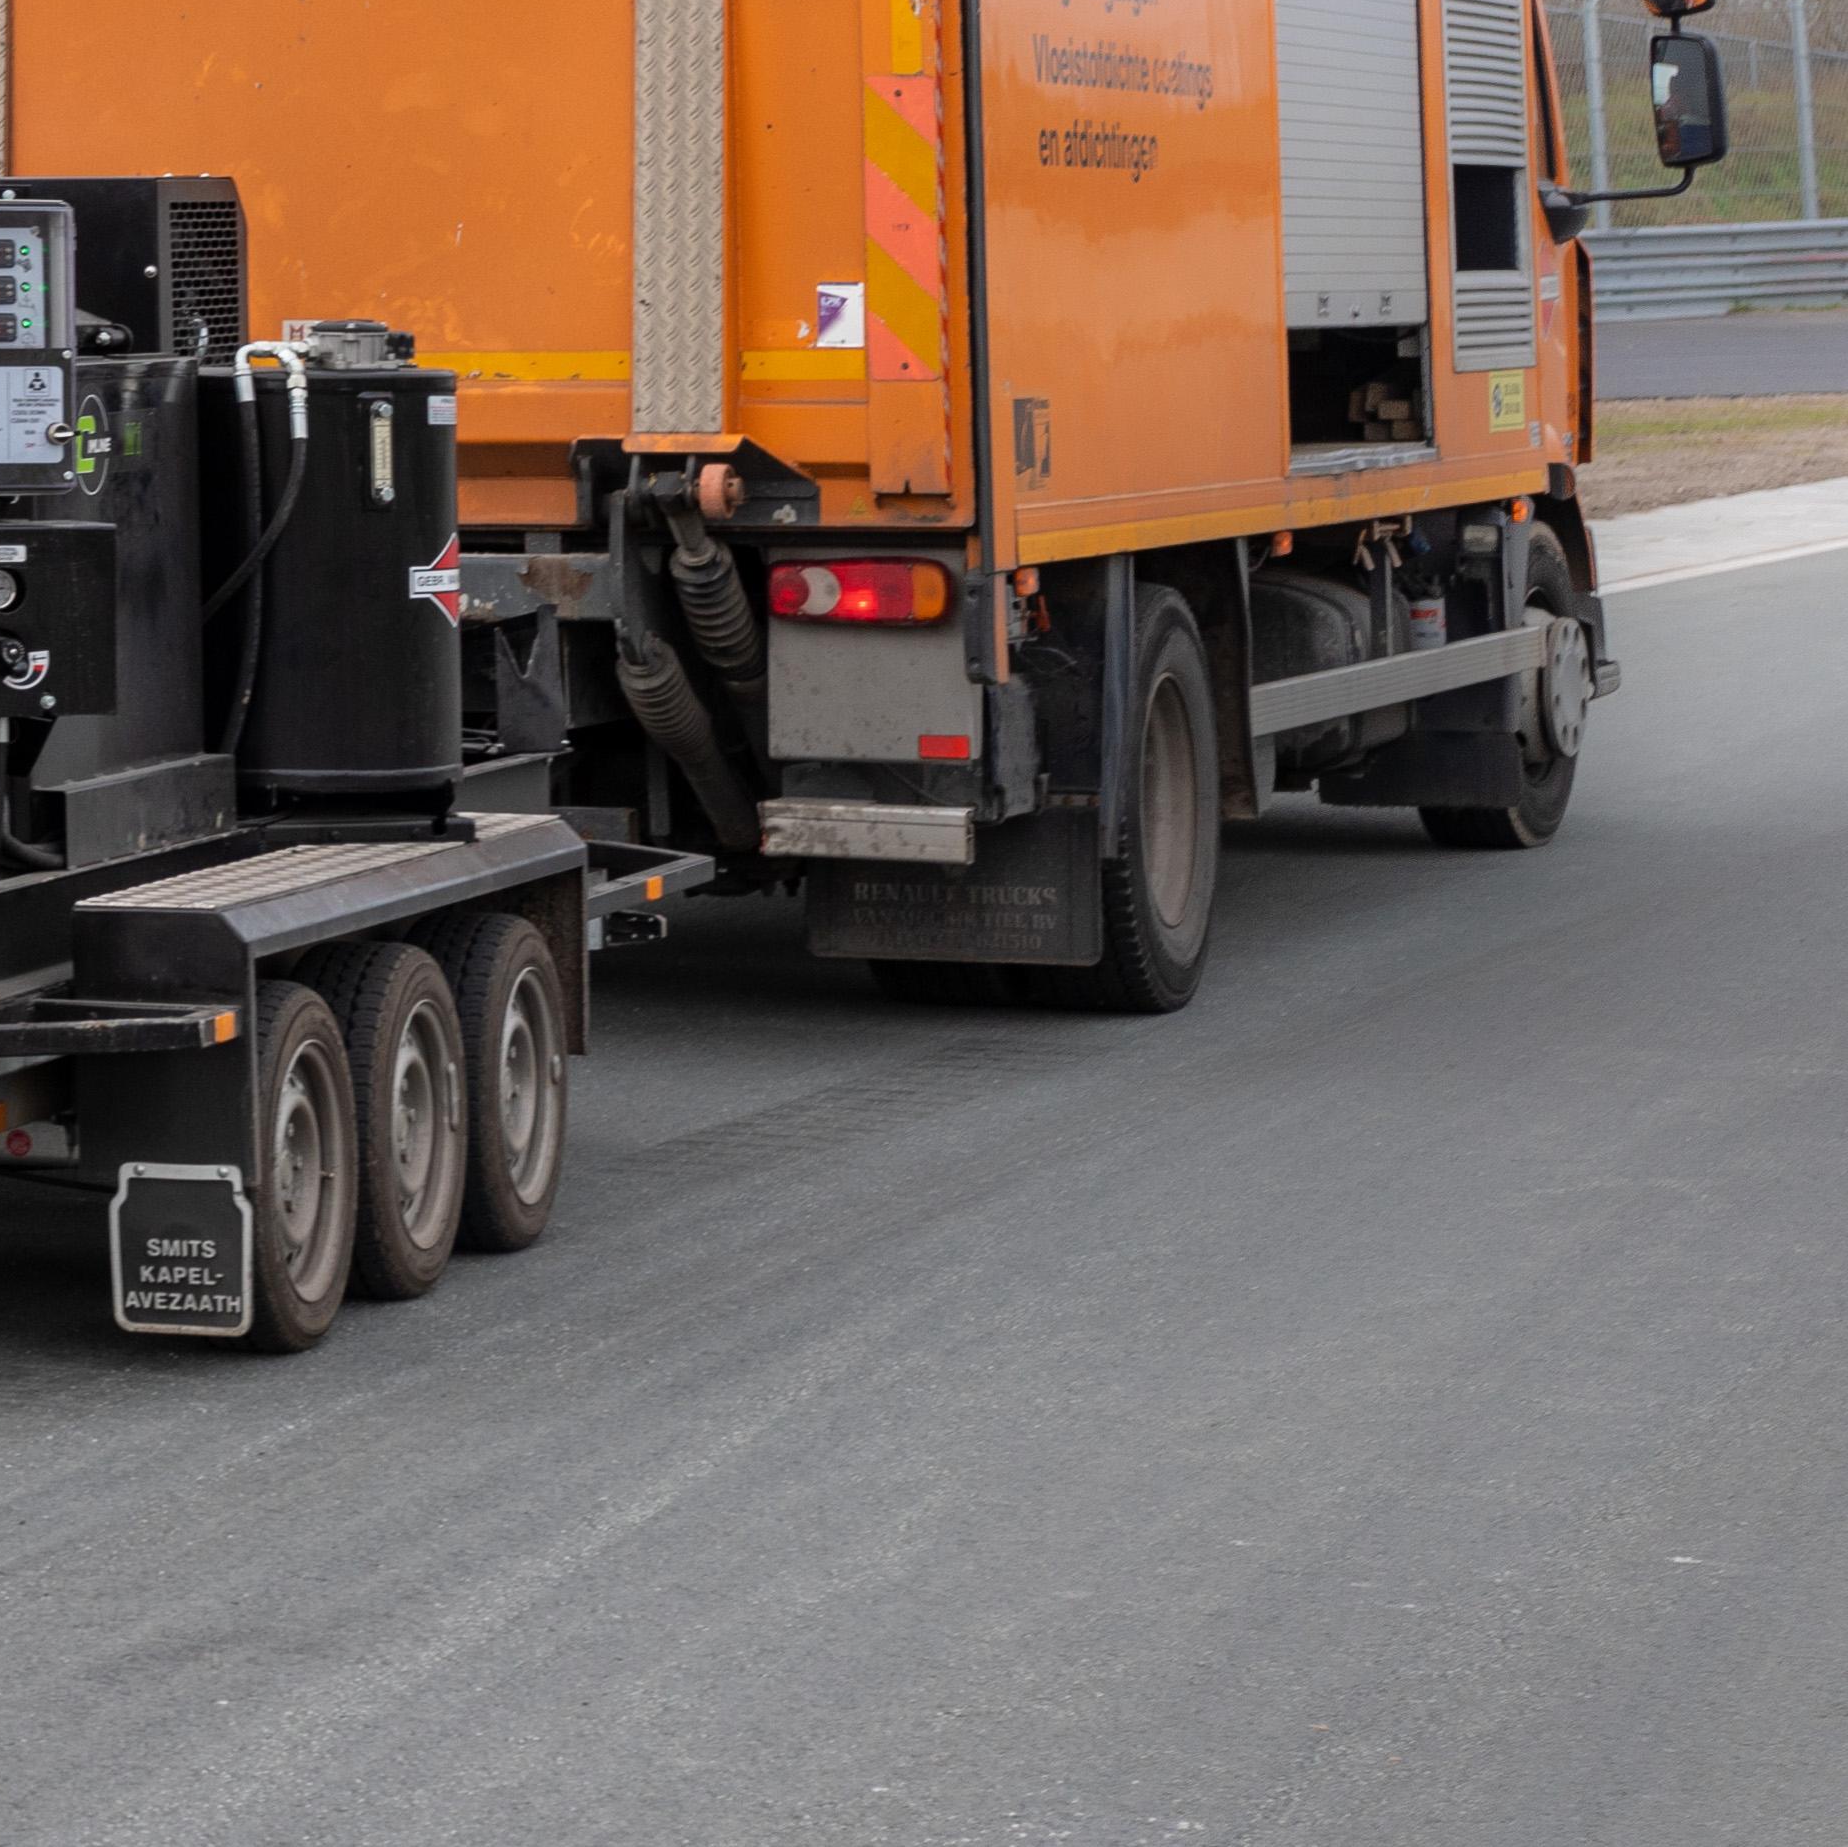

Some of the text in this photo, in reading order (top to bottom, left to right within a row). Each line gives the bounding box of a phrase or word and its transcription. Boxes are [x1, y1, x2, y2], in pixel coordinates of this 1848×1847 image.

[1032, 33, 1149, 92] Vloeistofdichte
[1039, 118, 1159, 183] en afdichtingen
[853, 882, 1058, 905] RENAULT TRUCKS
[146, 1238, 217, 1258] SMITS
[139, 1265, 225, 1286] KAPEL-
[125, 1290, 242, 1313] AVEZAATH
